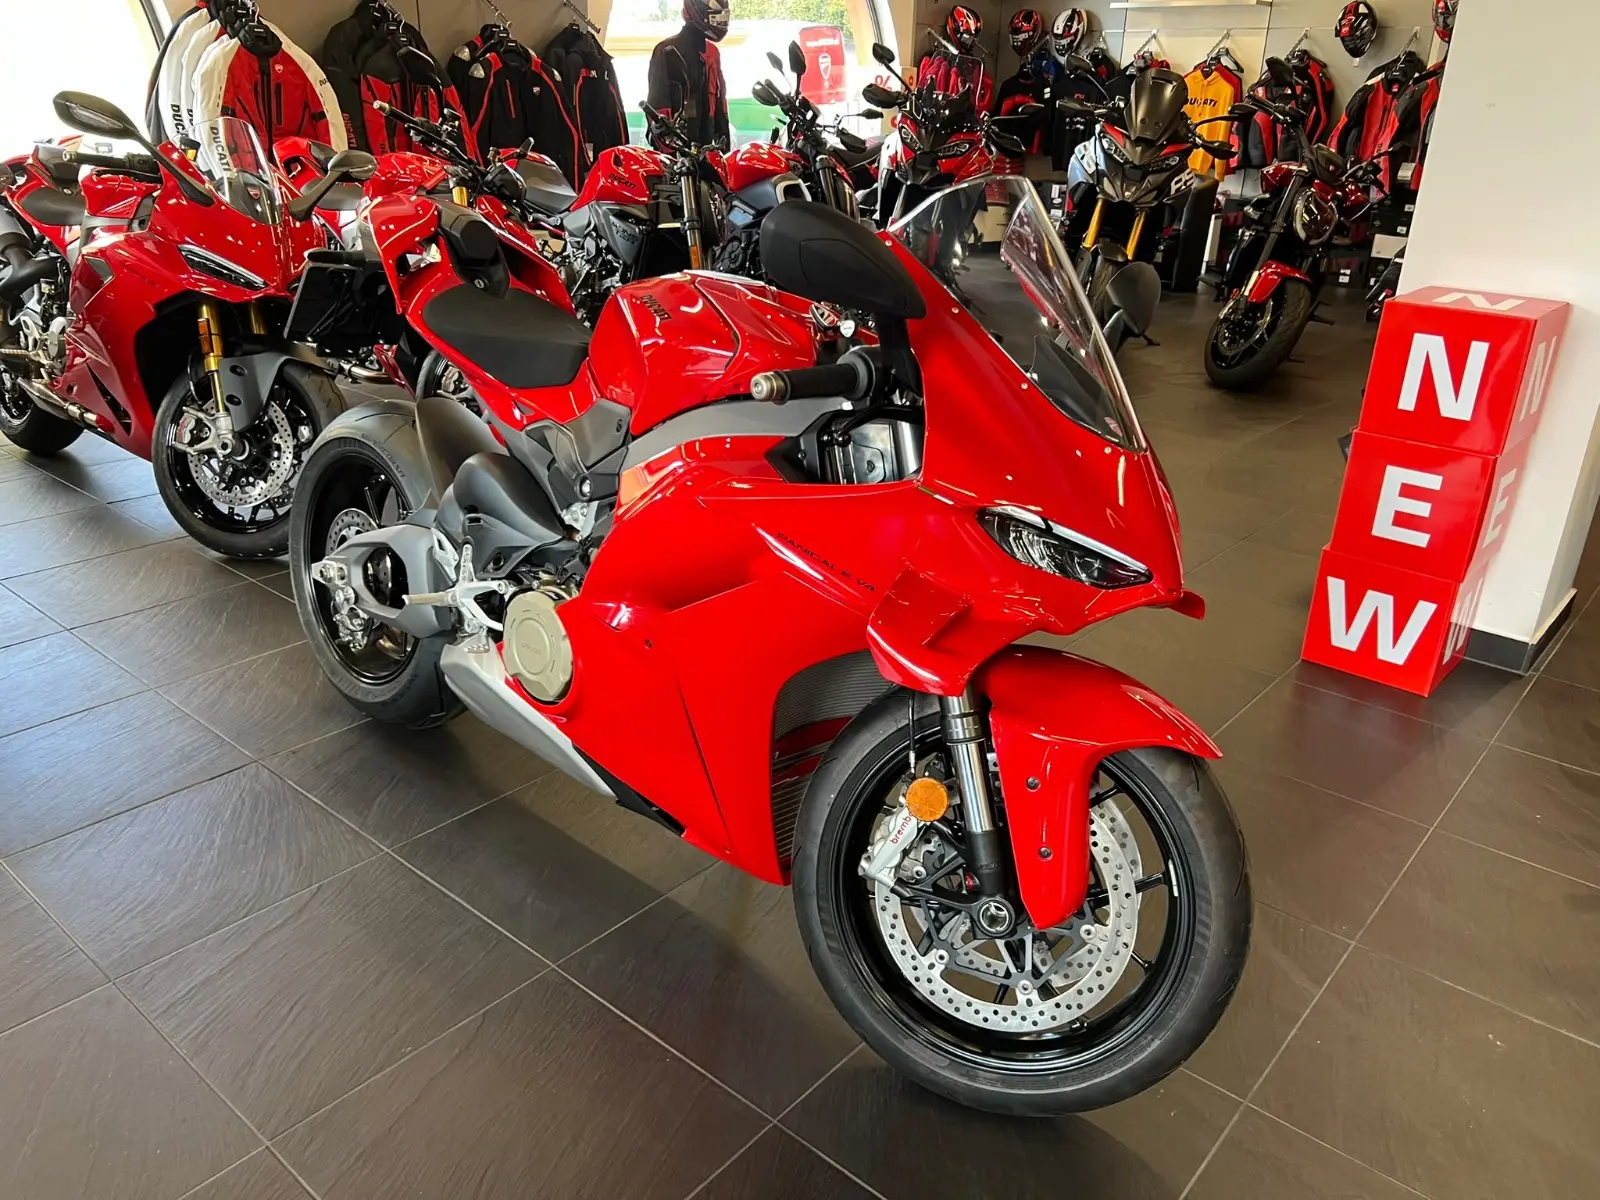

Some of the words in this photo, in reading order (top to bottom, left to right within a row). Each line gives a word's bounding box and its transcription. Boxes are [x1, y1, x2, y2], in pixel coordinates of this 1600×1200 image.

[210, 126, 232, 172] DUCATI
[608, 173, 637, 190] DUCATI
[641, 294, 672, 322] DUCATI
[890, 813, 913, 845] bremb
